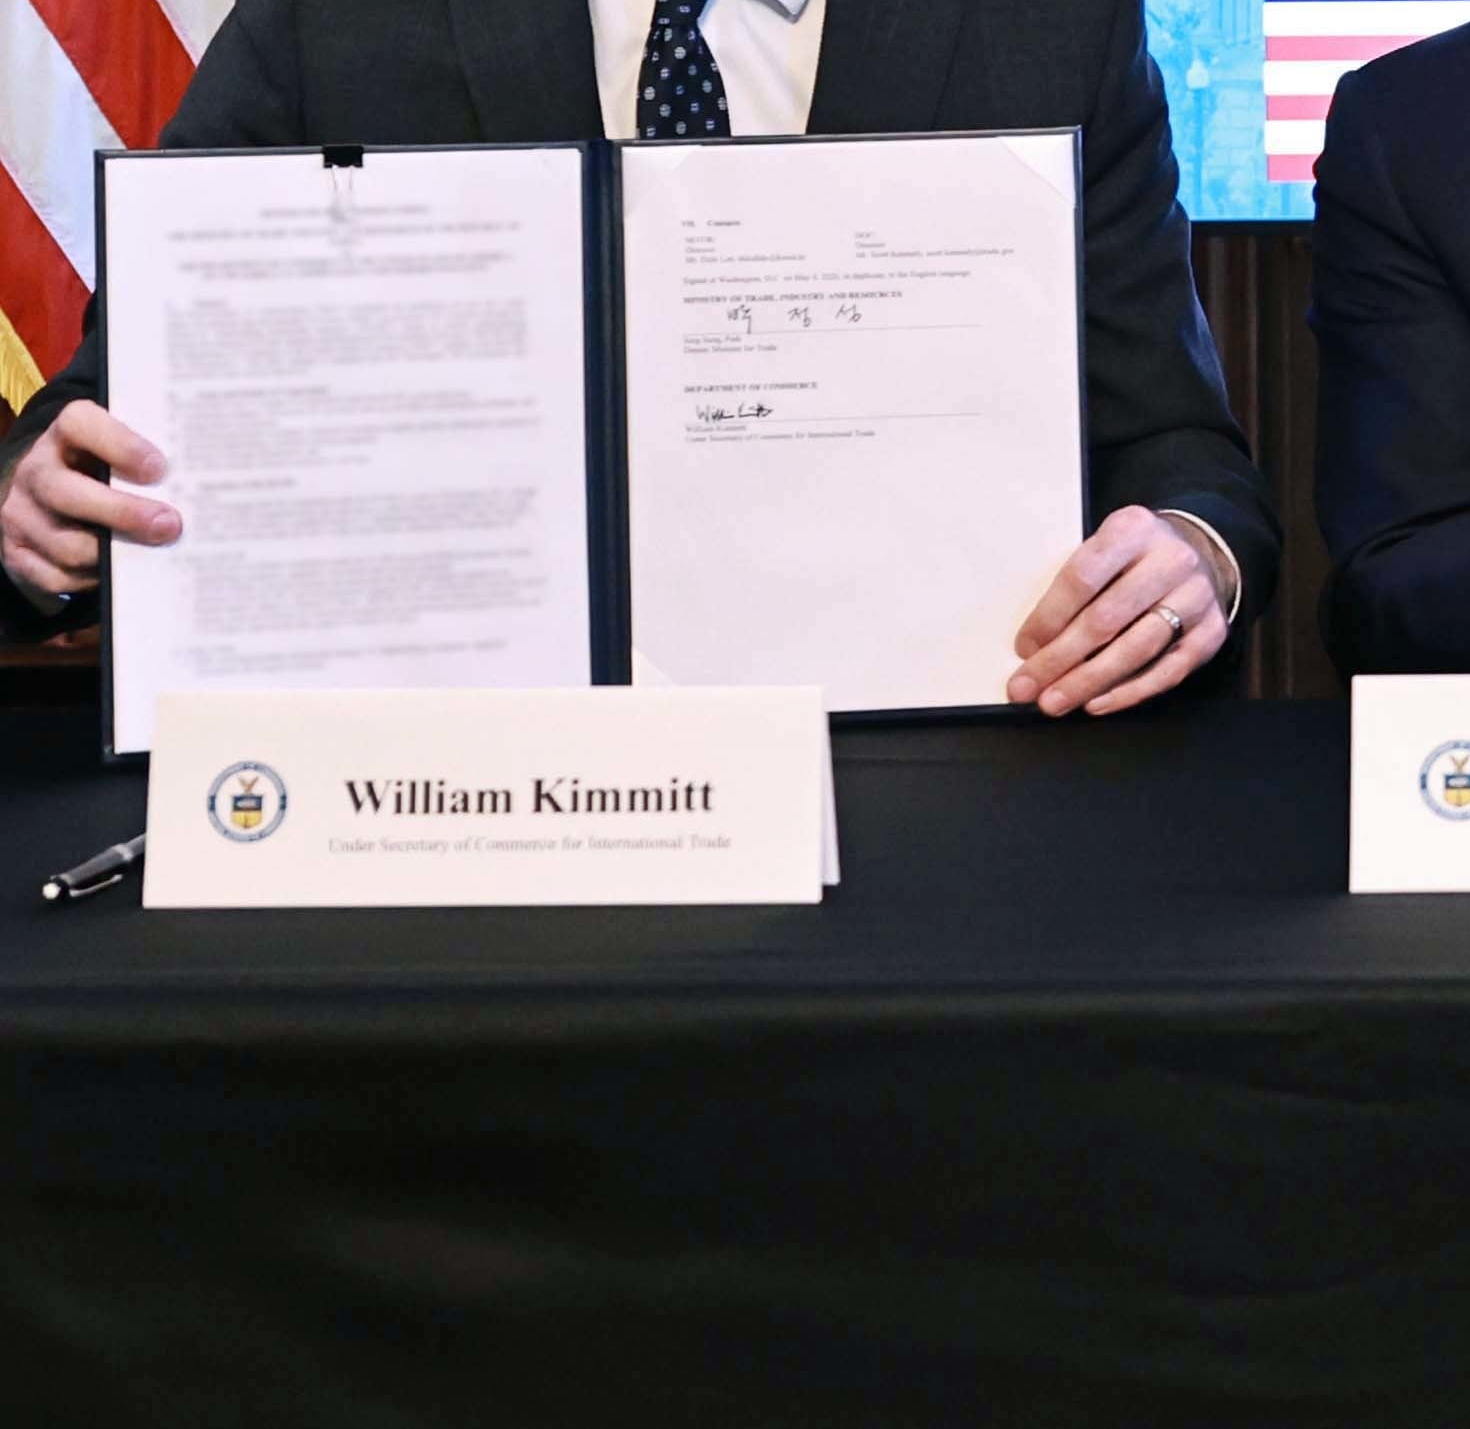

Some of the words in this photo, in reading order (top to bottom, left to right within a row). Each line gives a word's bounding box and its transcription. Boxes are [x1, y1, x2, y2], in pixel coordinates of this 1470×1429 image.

[346, 777, 513, 815] William
[532, 777, 715, 814] Kimmitt
[328, 837, 374, 853] Under
[379, 837, 448, 855] Secretary
[453, 835, 471, 852] of
[473, 835, 557, 852] Commerce
[561, 835, 582, 851] for
[587, 834, 684, 850] International
[690, 833, 732, 849] Trade
